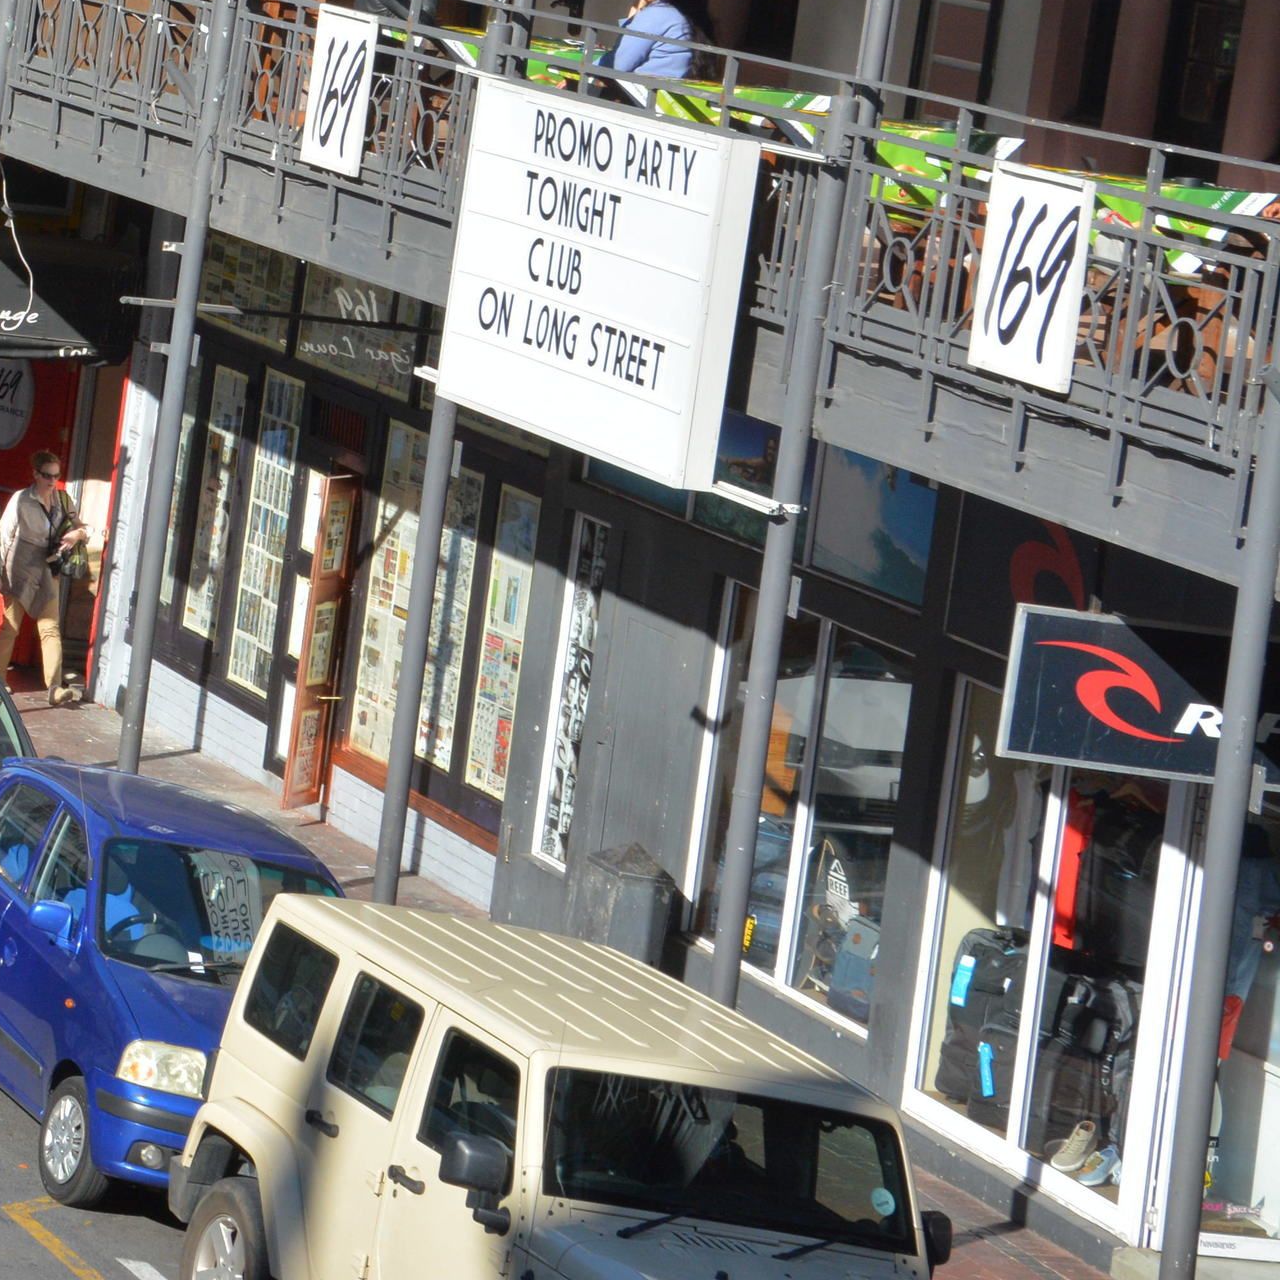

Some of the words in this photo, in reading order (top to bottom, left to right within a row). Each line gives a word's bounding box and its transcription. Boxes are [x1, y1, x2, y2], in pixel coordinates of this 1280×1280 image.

[312, 36, 367, 158] 169
[534, 109, 613, 172] PROMO
[624, 133, 697, 196] PARTY
[526, 170, 622, 241] TONIGHT
[528, 238, 582, 295] CLUB
[984, 195, 1082, 365] 169
[478, 286, 515, 338] ON
[523, 299, 580, 361] LONG
[587, 322, 666, 391] STREET
[829, 876, 849, 901] REEF
